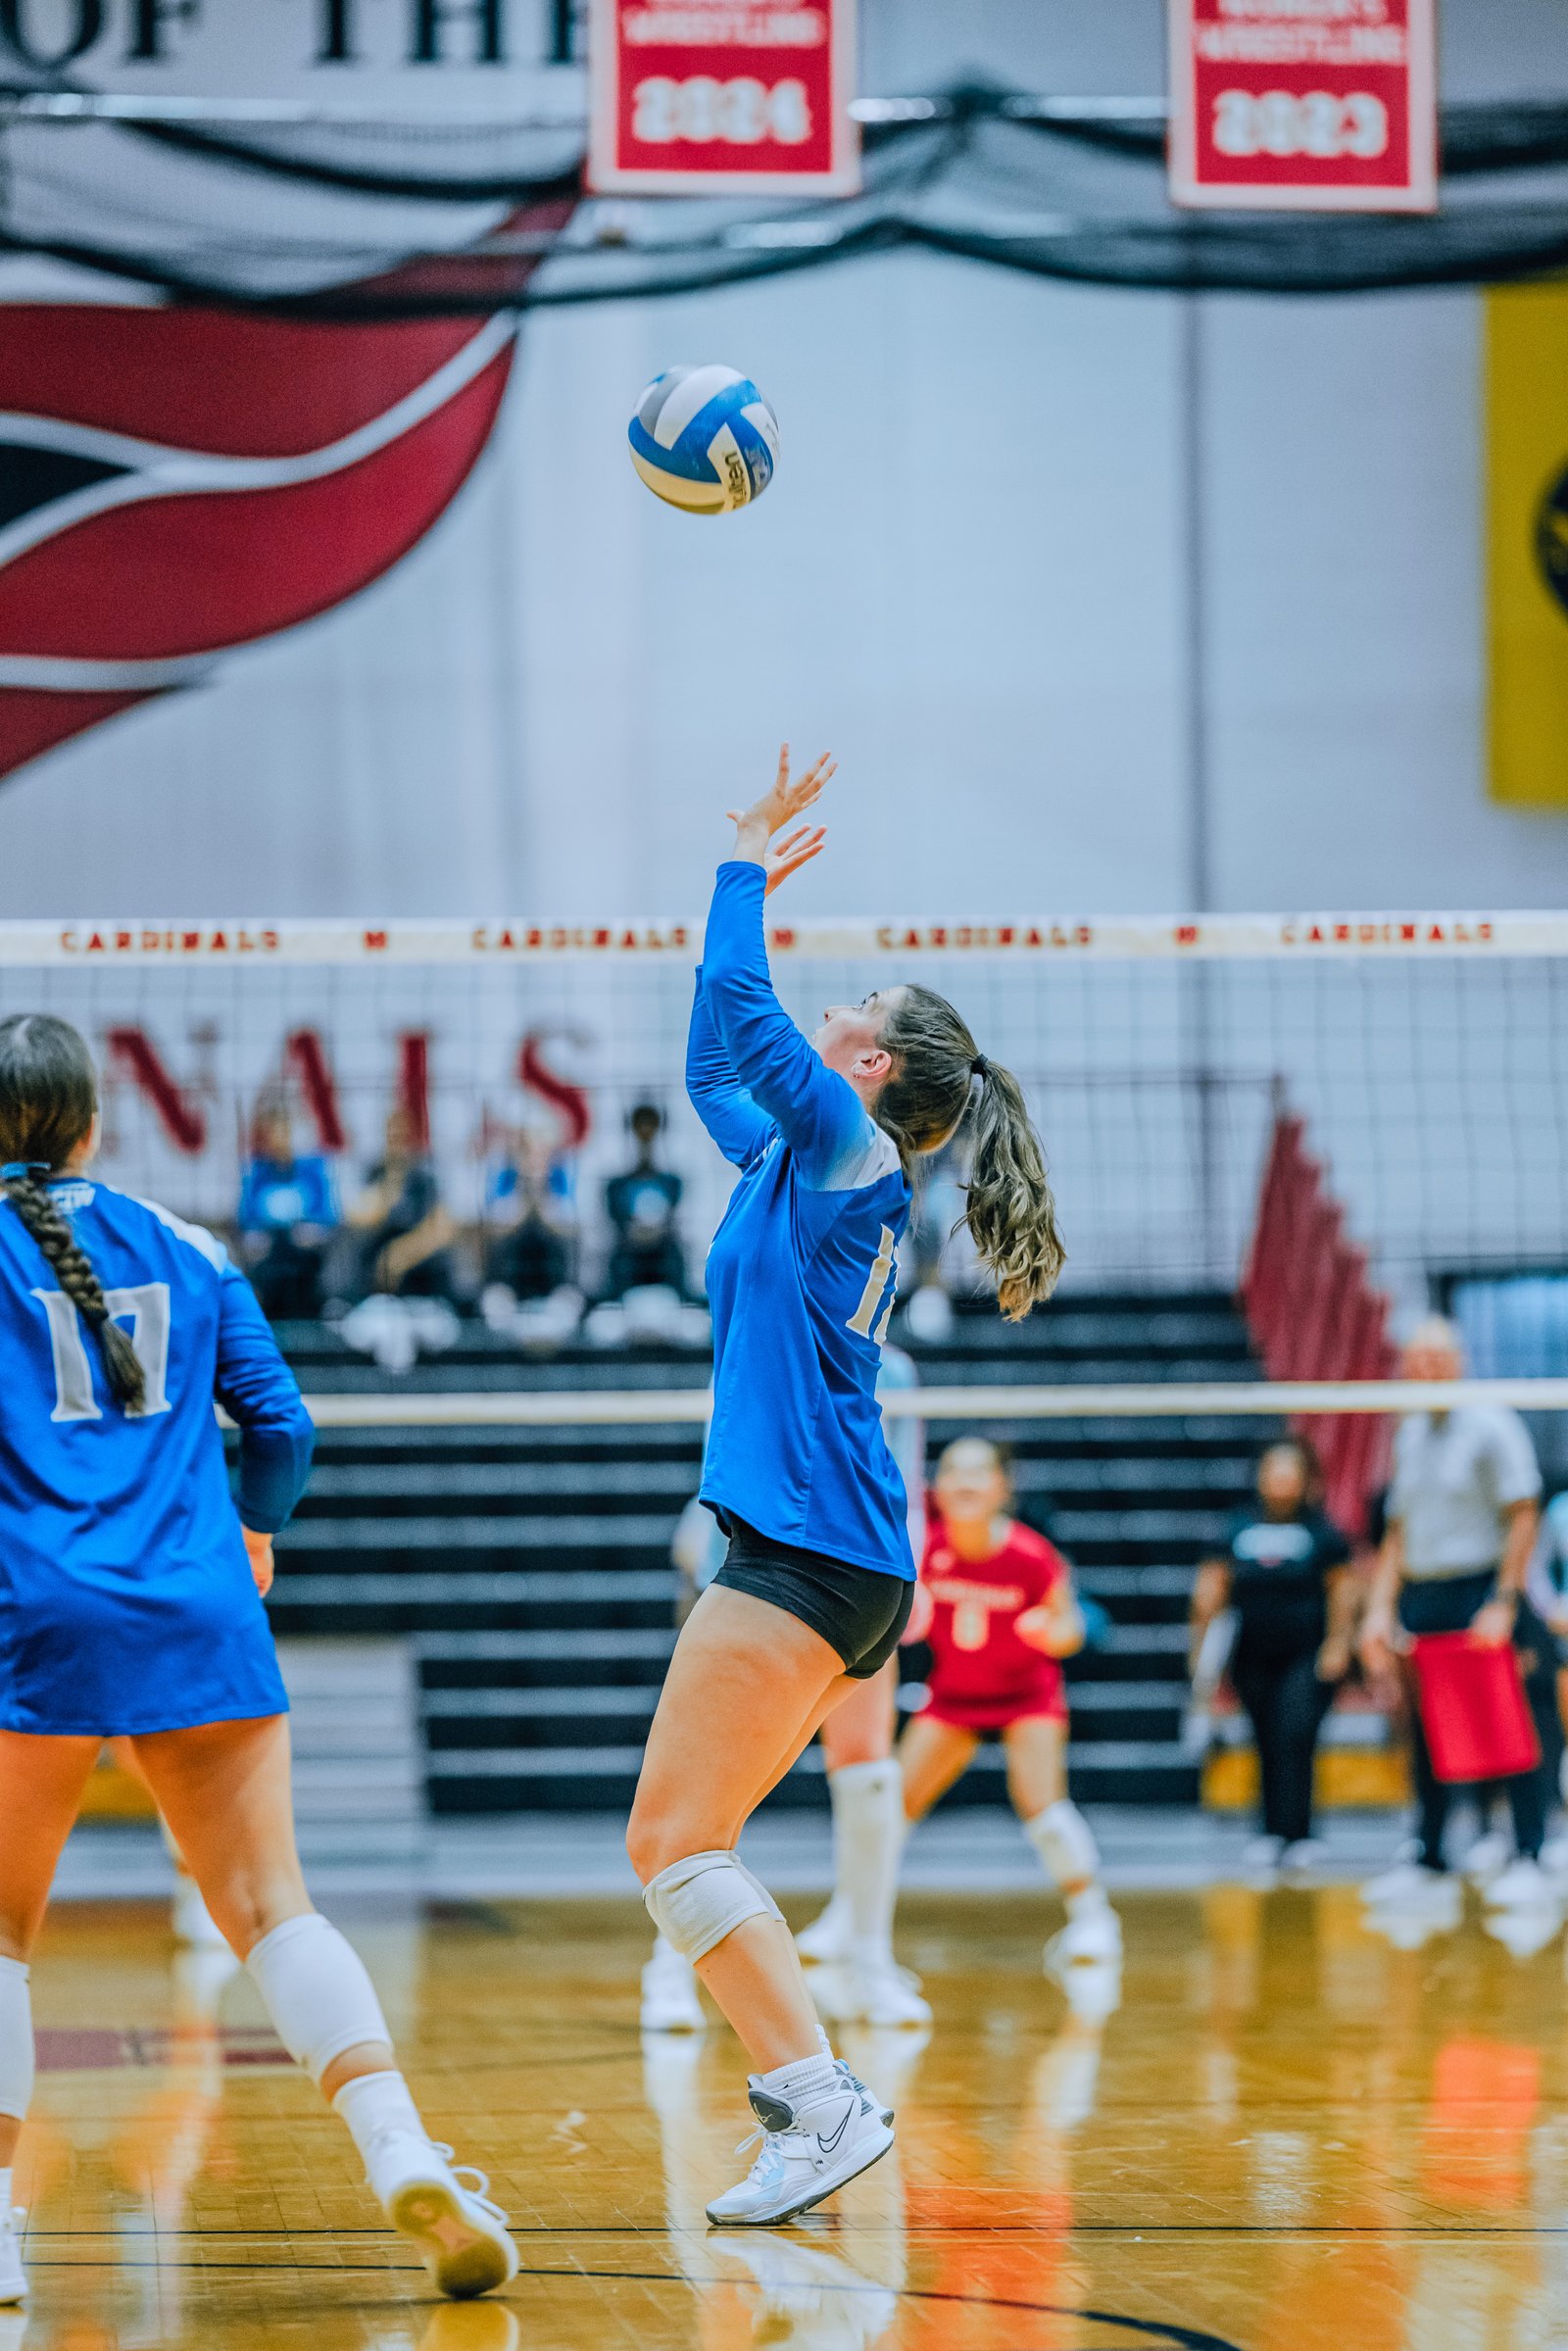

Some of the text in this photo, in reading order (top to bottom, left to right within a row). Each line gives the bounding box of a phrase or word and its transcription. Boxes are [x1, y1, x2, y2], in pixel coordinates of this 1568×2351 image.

[1212, 88, 1389, 159] 2023
[724, 451, 748, 509] olten
[60, 929, 280, 953] CARDINALS
[471, 927, 688, 951] CARDINALS
[877, 925, 1093, 950] CARDINALS
[1280, 922, 1494, 945] CARDINALS
[29, 1281, 172, 1423] 17
